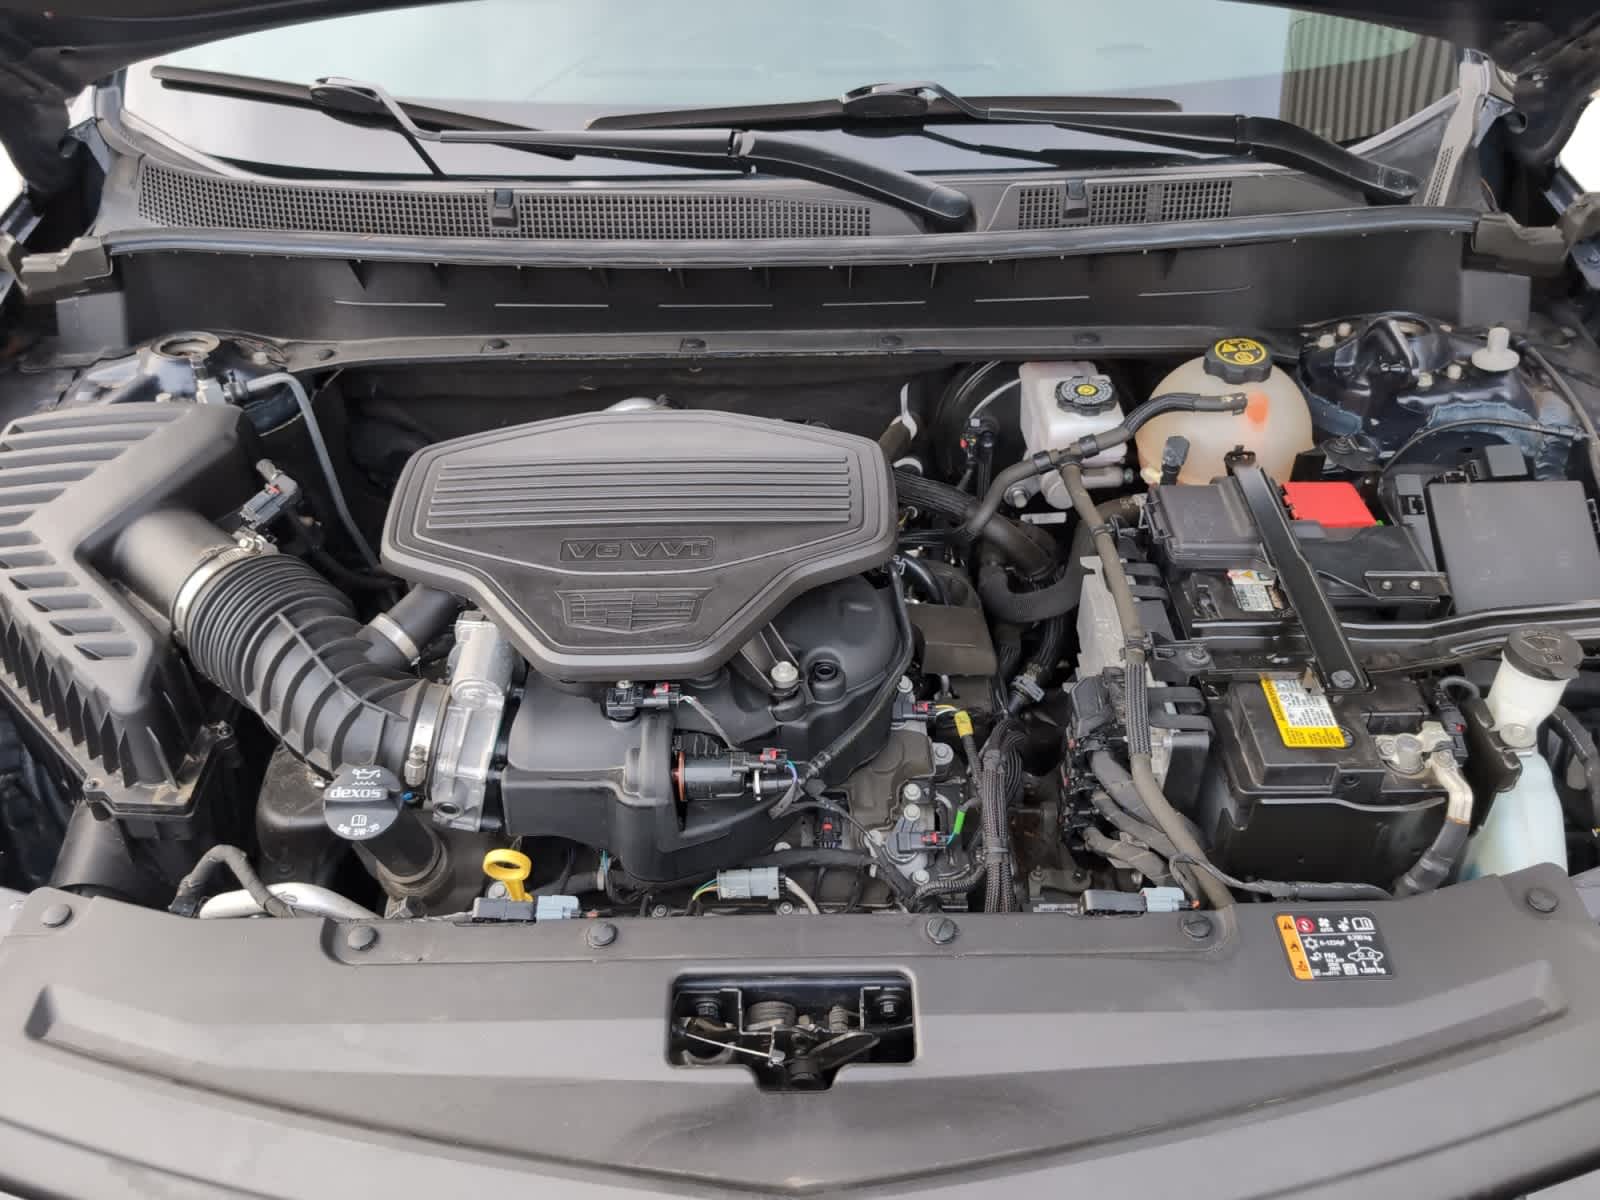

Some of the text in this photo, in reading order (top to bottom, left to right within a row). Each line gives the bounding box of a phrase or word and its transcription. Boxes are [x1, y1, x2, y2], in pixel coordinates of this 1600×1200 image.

[567, 540, 710, 558] V6 VVT
[329, 786, 381, 799] dexos
